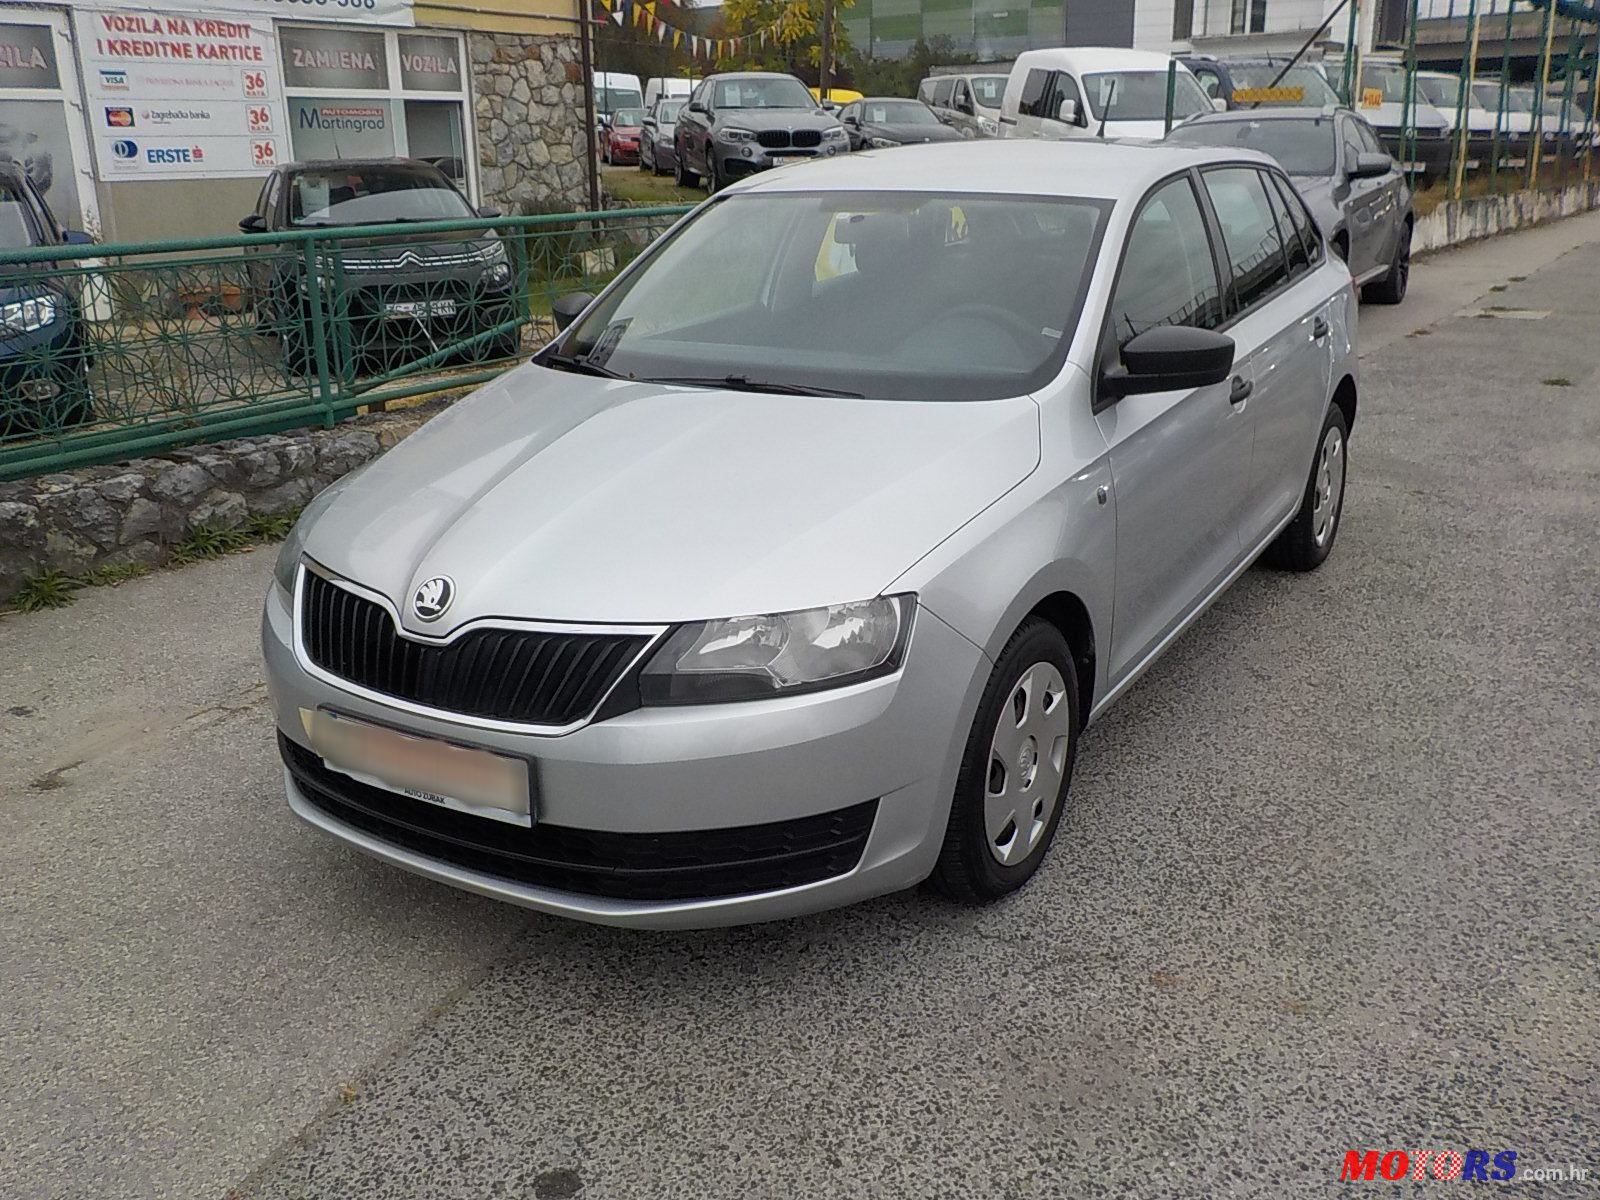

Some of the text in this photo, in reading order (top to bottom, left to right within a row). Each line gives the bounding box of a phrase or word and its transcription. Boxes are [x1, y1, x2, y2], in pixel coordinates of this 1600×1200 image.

[101, 15, 252, 39] VOZILA NA KREDIT
[96, 39, 262, 61] I KREDITNE KARTICE
[292, 48, 375, 71] ZAMJENA
[402, 54, 457, 74] VOZILA
[104, 76, 125, 84] VISA
[244, 73, 265, 91] 36
[189, 111, 210, 120] banka
[249, 107, 269, 125] 36
[300, 107, 385, 133] Martingrad
[147, 149, 191, 164] ERSTE
[254, 139, 274, 159] 36
